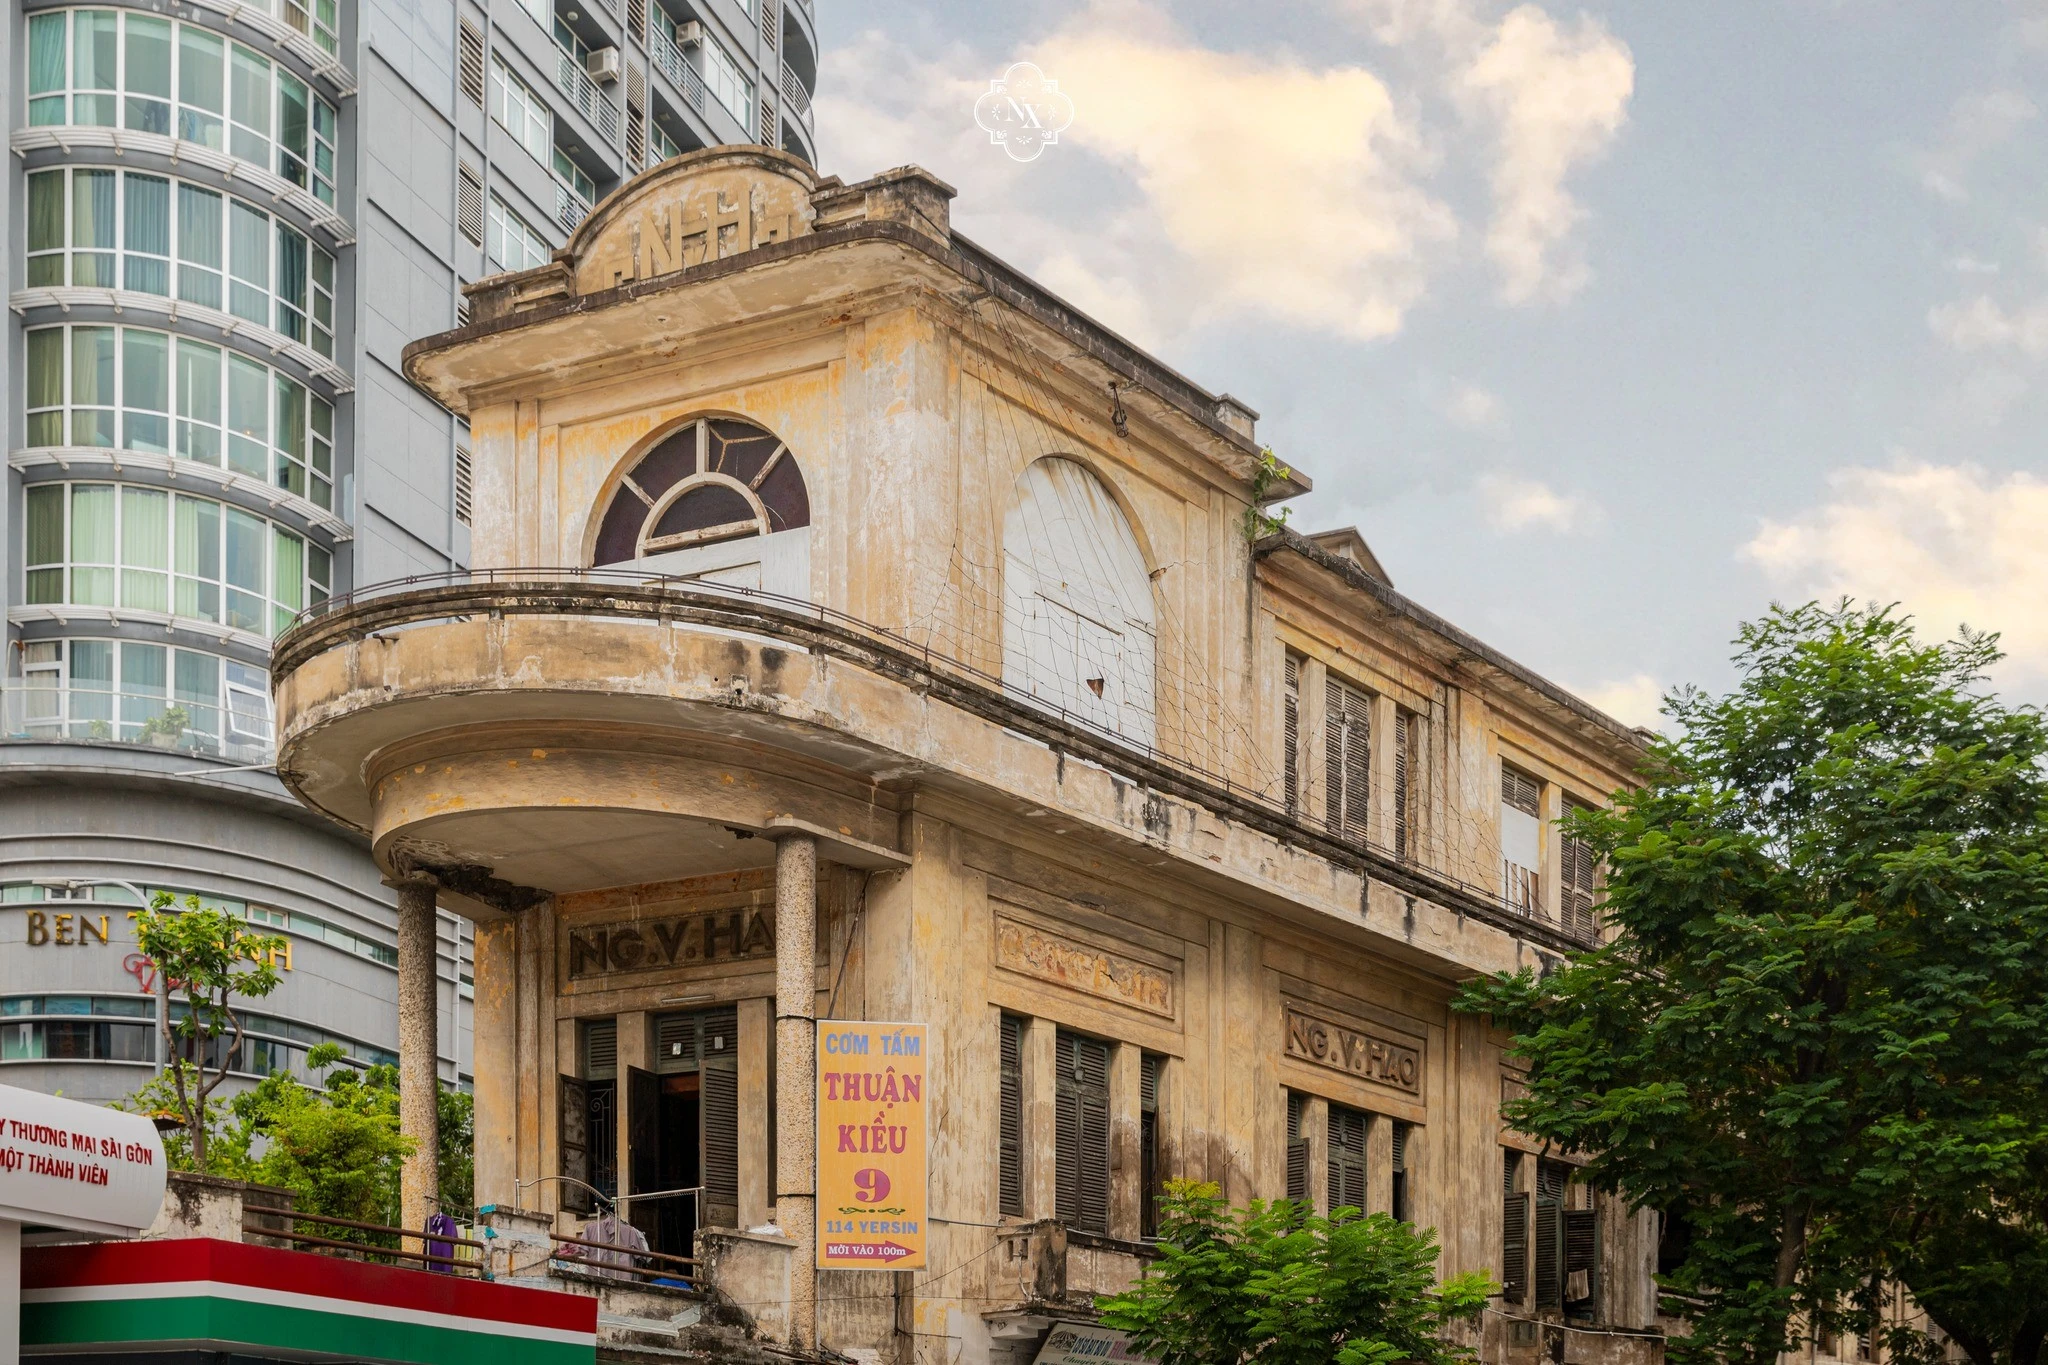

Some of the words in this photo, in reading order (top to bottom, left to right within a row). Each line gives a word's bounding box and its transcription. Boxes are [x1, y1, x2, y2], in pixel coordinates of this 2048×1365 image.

[25, 909, 110, 946] BEN
[570, 912, 776, 974] NG.V.HA
[825, 1031, 869, 1055] CƠM
[880, 1028, 920, 1056] TẤM
[824, 1066, 921, 1109] THUẬN
[9, 1119, 67, 1149] THƯƠNG
[72, 1132, 97, 1157] MẠI
[101, 1137, 122, 1160] SÀI
[126, 1142, 153, 1166] GÒN
[837, 1111, 907, 1154] KIỀU
[28, 1153, 75, 1181] THÀNH
[78, 1162, 109, 1186] VIÊN
[854, 1168, 891, 1203] 9
[826, 1220, 854, 1234] 114
[859, 1221, 918, 1235] YERSIN
[852, 1244, 874, 1256] VÀO
[878, 1246, 906, 1256] 100m
